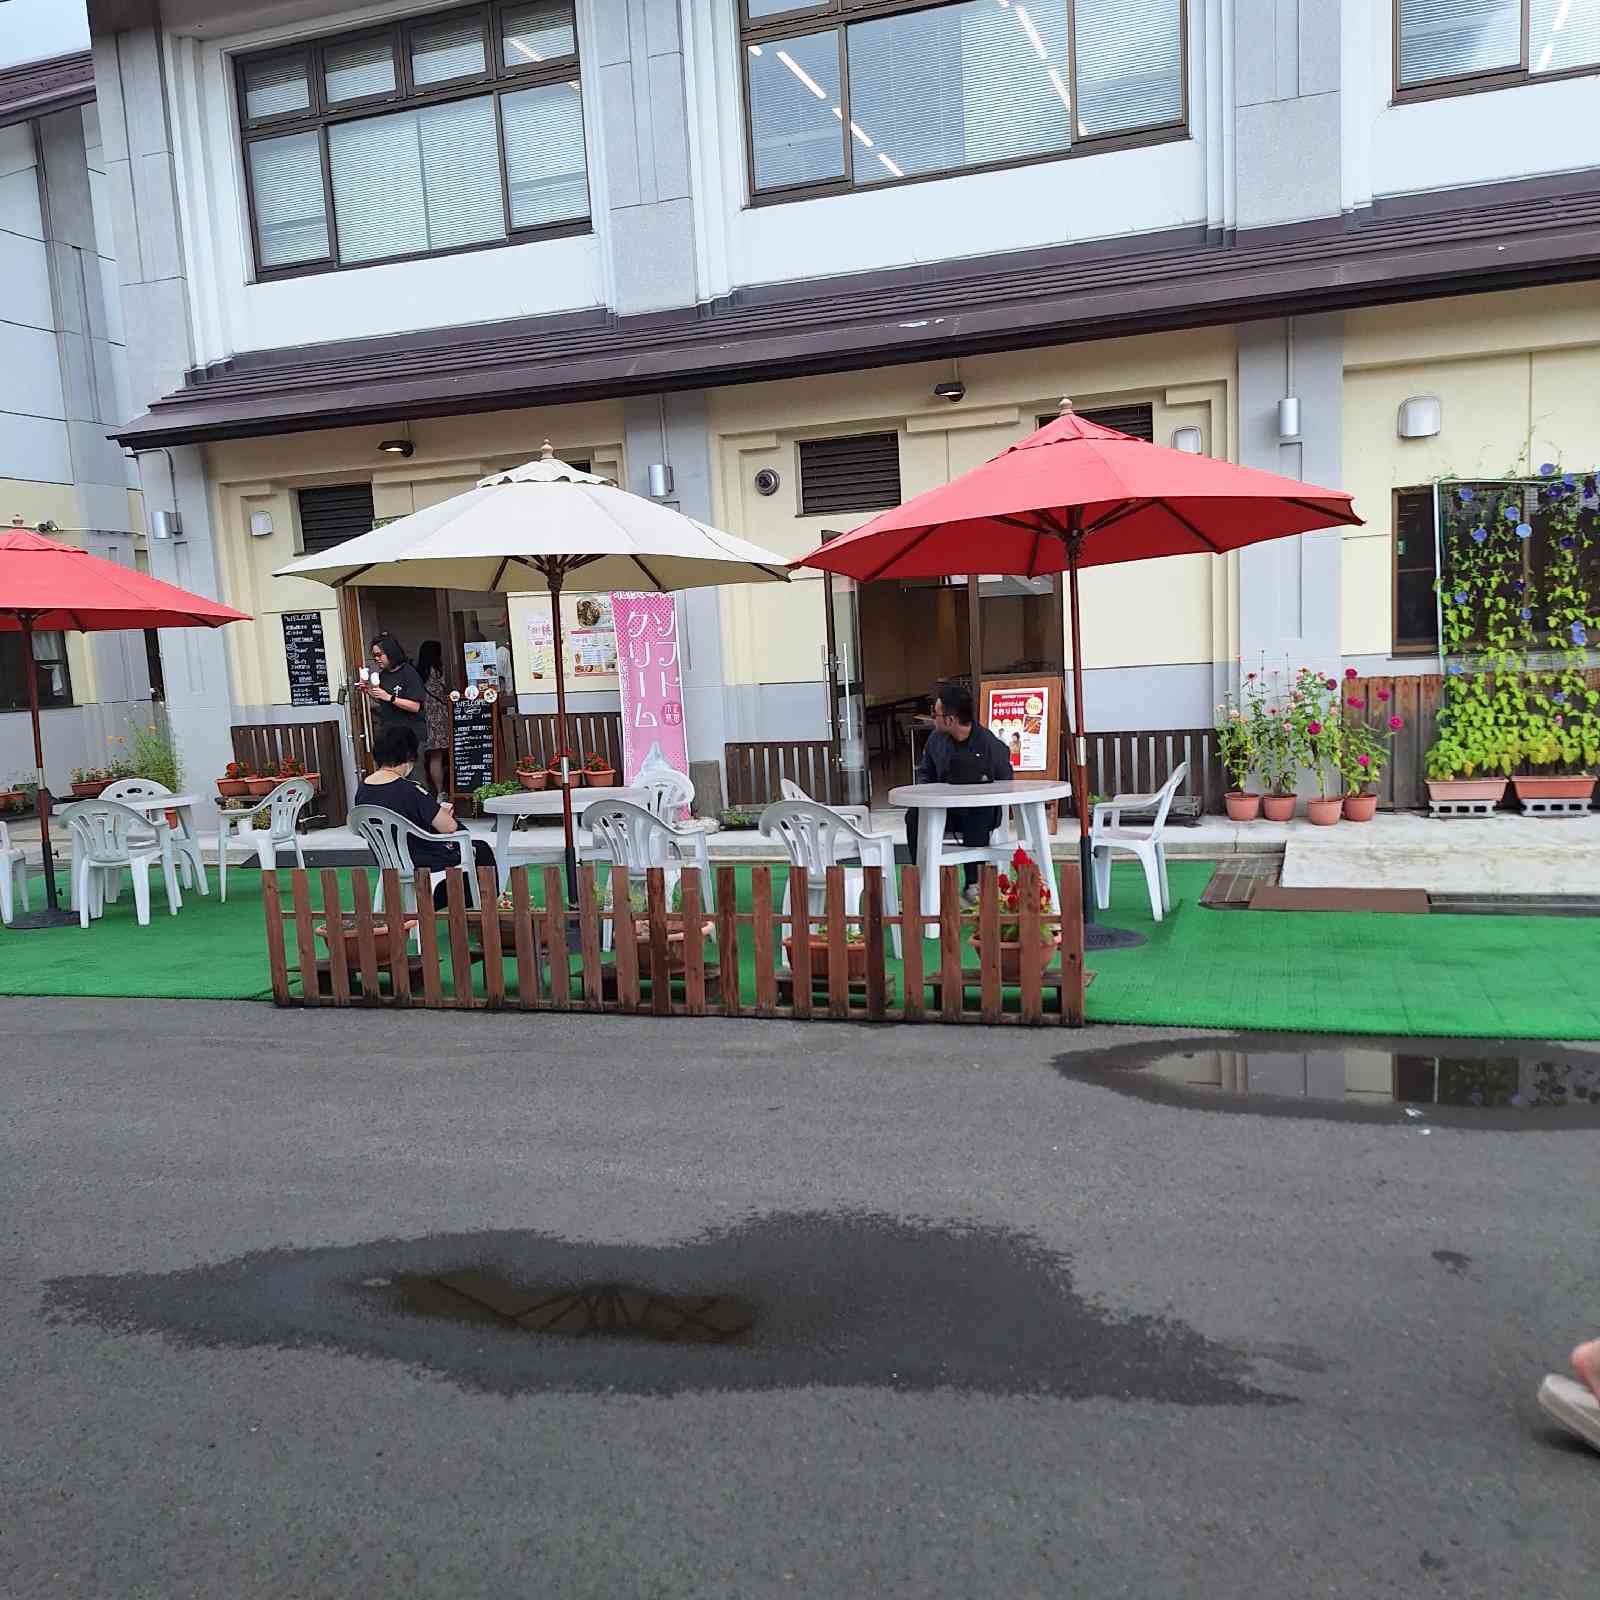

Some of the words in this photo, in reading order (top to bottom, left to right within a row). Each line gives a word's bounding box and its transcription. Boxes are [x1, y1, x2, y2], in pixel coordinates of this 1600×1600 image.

[626, 610, 659, 728] クリーム
[652, 610, 681, 698] ソフト
